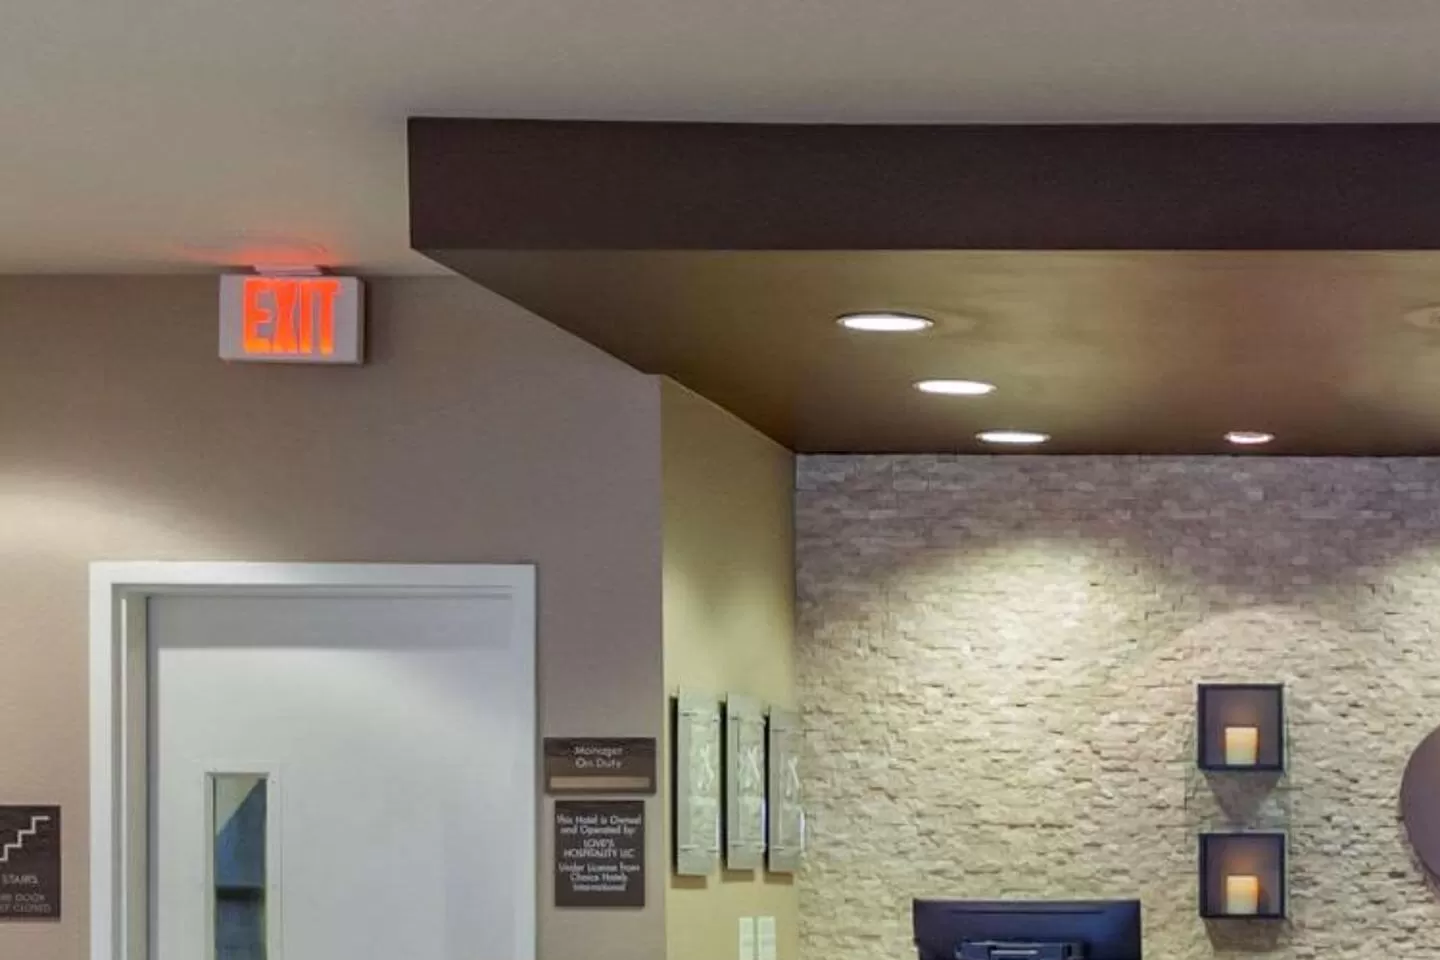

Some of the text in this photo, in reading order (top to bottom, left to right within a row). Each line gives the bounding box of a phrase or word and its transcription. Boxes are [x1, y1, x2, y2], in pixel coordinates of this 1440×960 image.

[244, 278, 342, 356] EXIT
[574, 746, 623, 758] Manager
[575, 757, 623, 769] On Duty
[576, 814, 598, 825] Hotel
[600, 814, 608, 825] is
[610, 814, 641, 825] Owned
[560, 825, 577, 834] and
[580, 825, 621, 837] Operated
[563, 848, 617, 858] HOSPITALITY
[558, 862, 585, 872] Under
[619, 862, 640, 872] from
[570, 873, 628, 882] Choice Hotels
